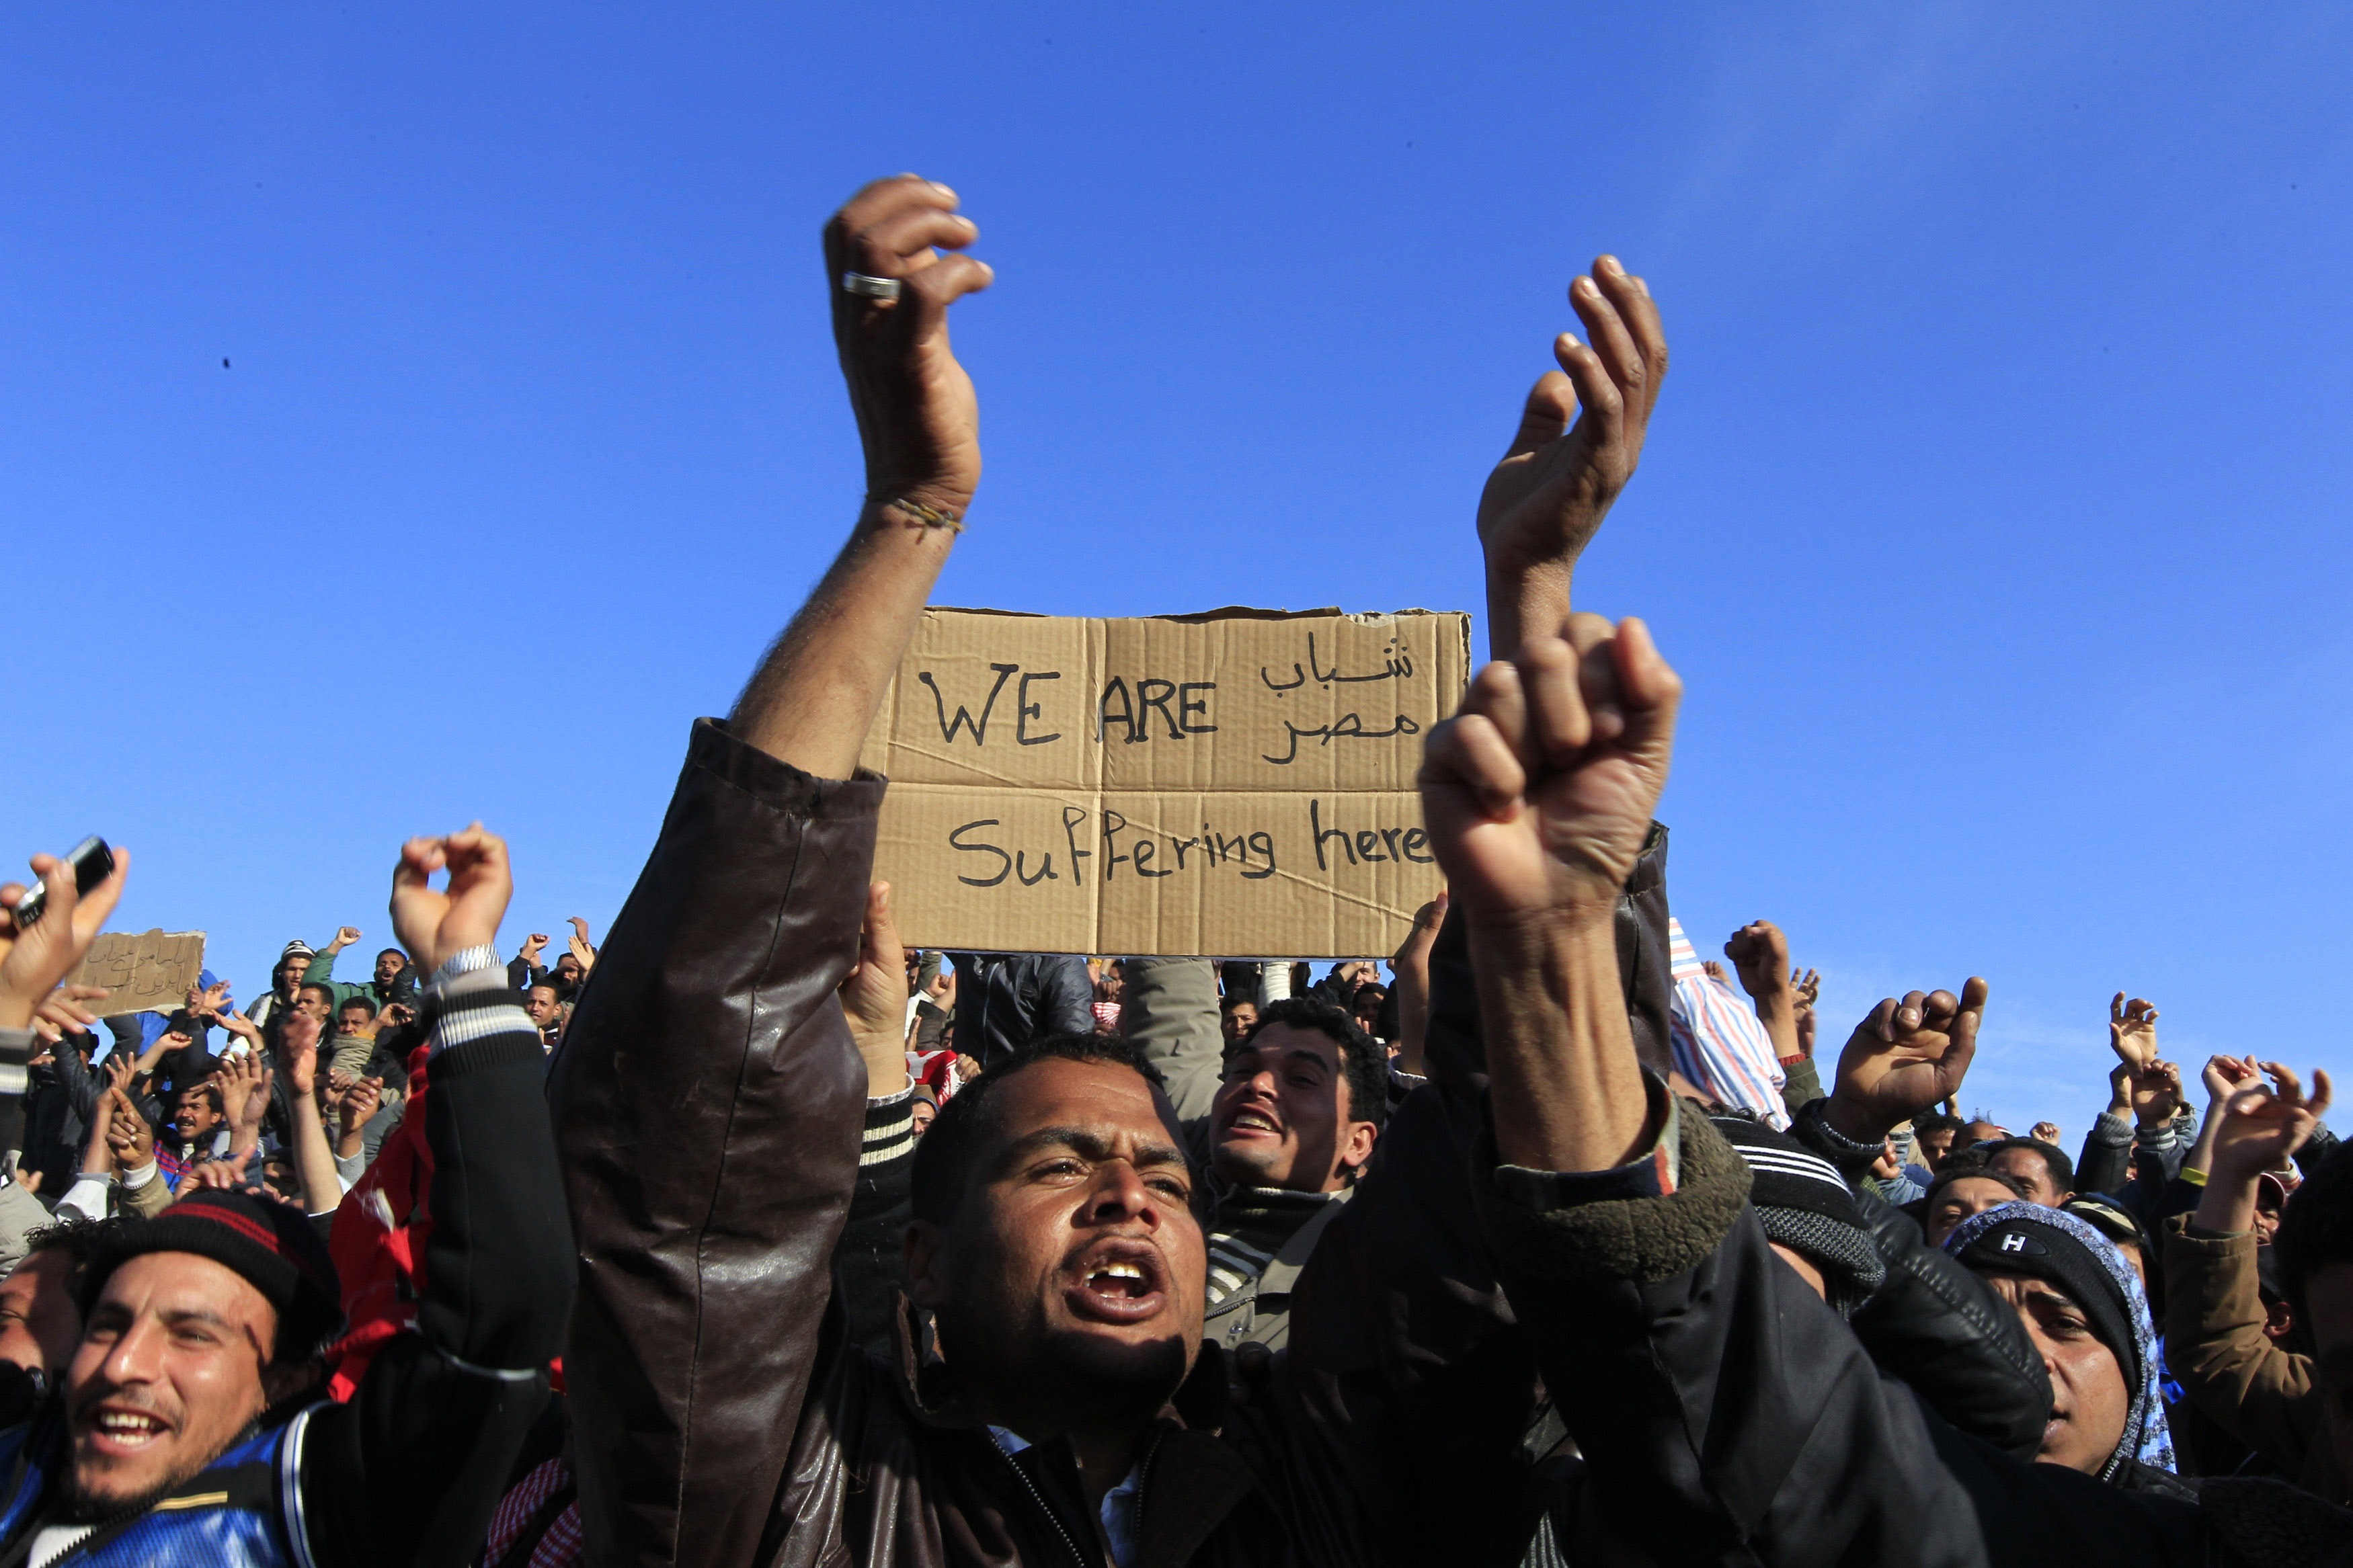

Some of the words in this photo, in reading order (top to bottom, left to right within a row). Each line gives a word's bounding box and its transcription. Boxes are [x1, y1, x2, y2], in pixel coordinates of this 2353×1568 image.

[1261, 630, 1413, 698] شباب
[918, 663, 1062, 746] WE
[1094, 675, 1219, 745] ARE
[1261, 712, 1420, 765] مصر
[949, 806, 1276, 887] Suffering
[1310, 798, 1435, 871] here
[2001, 1233, 2027, 1252] H
